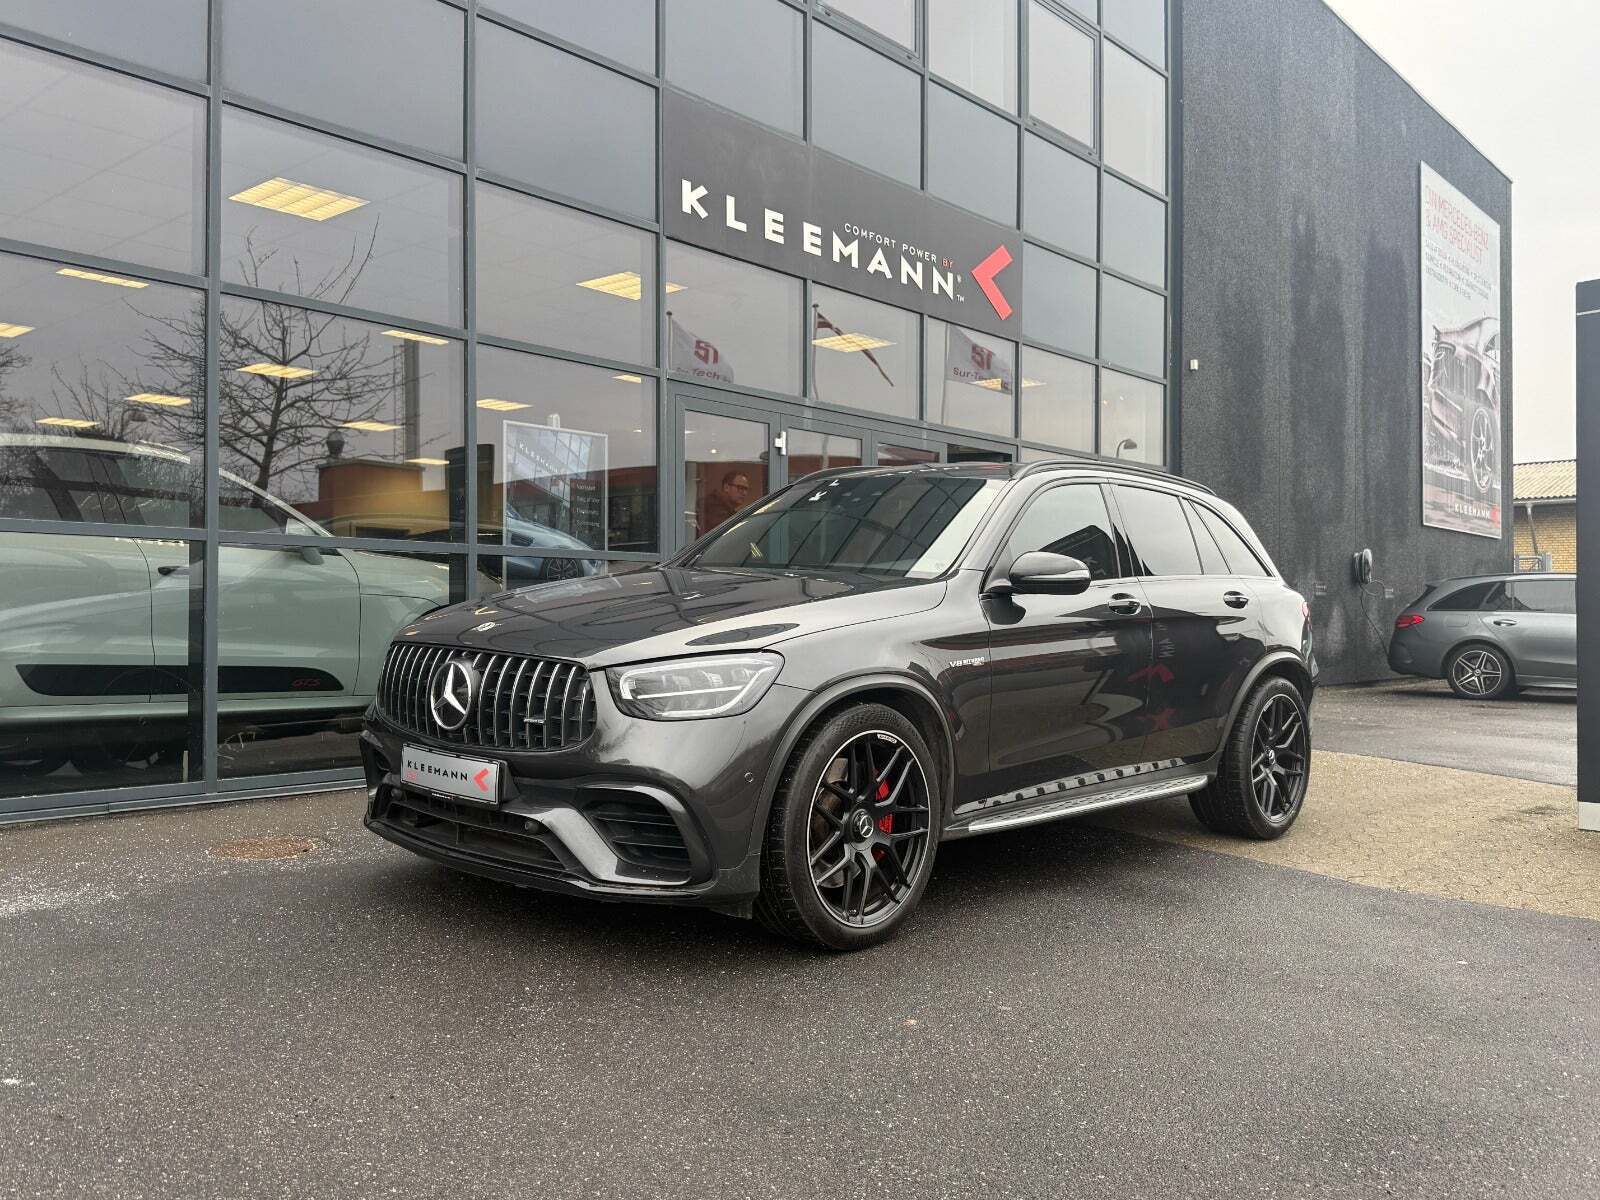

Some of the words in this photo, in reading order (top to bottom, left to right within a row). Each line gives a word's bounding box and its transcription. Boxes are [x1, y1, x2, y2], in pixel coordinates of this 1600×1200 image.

[681, 178, 954, 301] KLEEMANN
[844, 222, 897, 249] COMFORT
[902, 243, 937, 264] POWER
[942, 258, 954, 269] BY
[1454, 503, 1490, 520] KLEEMANN
[407, 759, 468, 781] KLEEMANN
